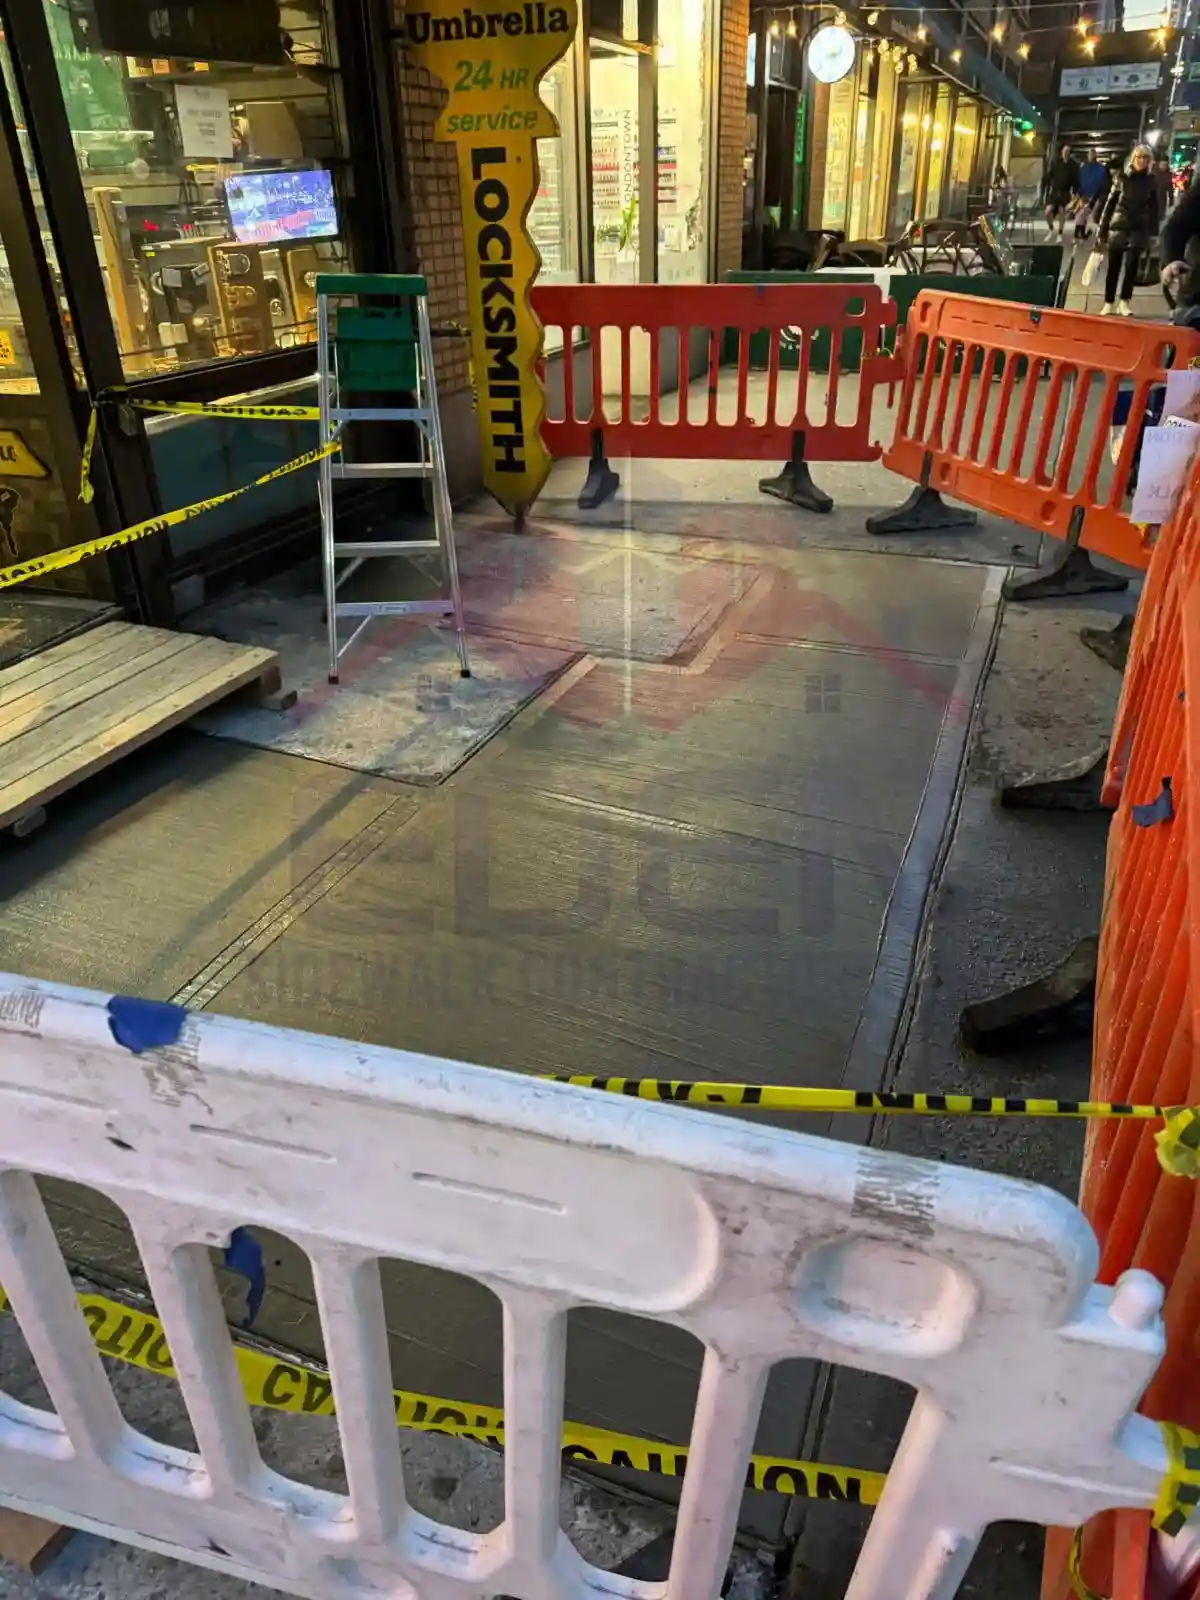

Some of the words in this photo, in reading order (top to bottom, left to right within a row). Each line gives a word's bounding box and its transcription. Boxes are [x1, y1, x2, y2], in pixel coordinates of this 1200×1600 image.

[405, 2, 570, 44] Umbrella
[453, 59, 495, 92] 24
[500, 68, 529, 89] HR
[446, 104, 538, 133] service
[471, 146, 527, 474] LOCKSMITH
